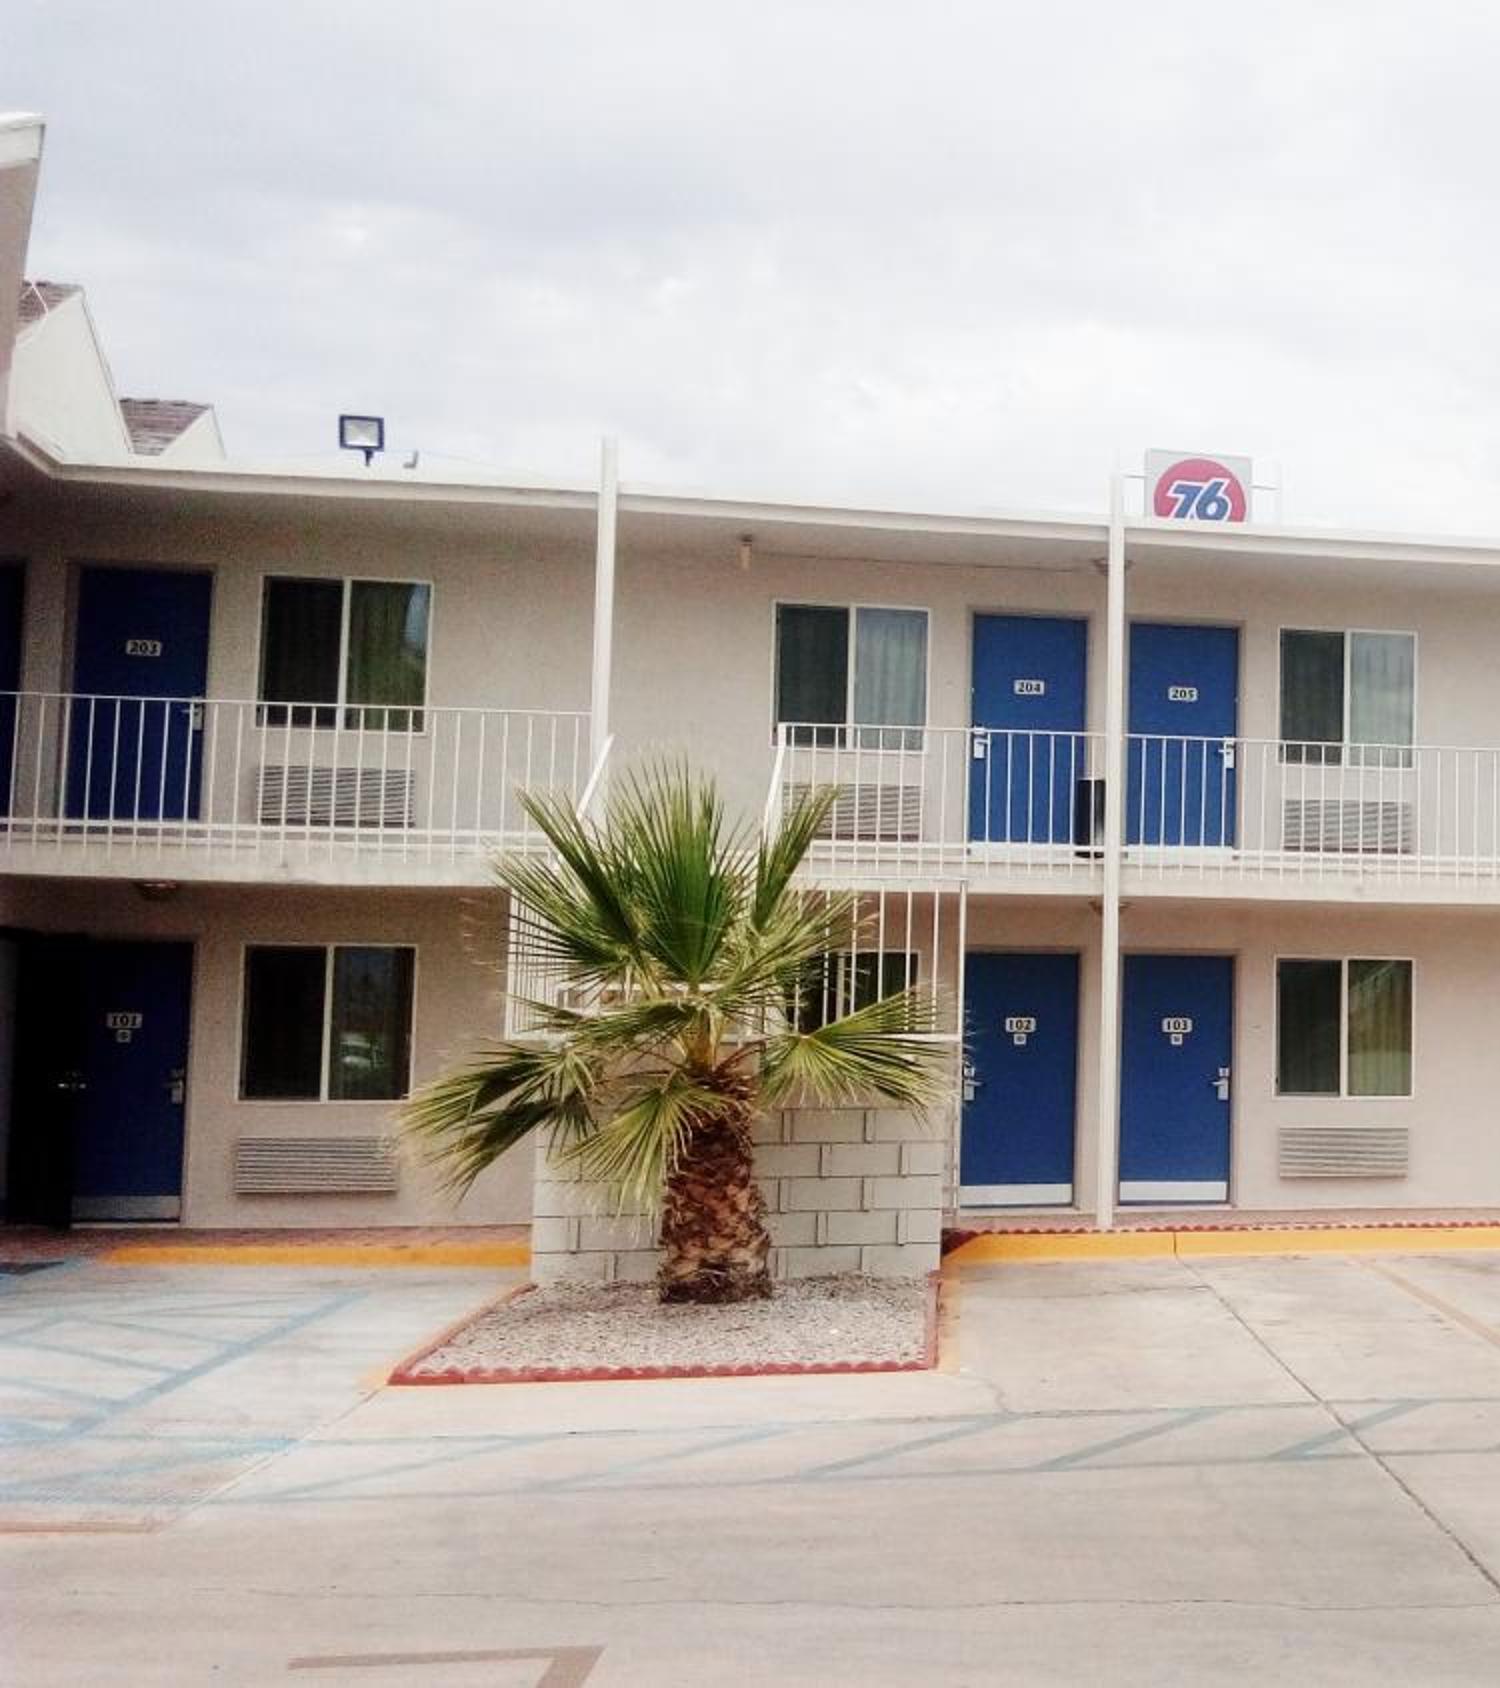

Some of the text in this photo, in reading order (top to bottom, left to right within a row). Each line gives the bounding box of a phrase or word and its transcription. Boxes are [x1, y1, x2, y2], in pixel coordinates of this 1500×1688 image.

[1166, 478, 1232, 520] 76
[131, 641, 158, 655] 203
[1017, 681, 1041, 693] 204
[1172, 687, 1195, 700] 205
[112, 1014, 138, 1027] 101
[1009, 1019, 1032, 1031] 102
[1166, 1019, 1189, 1031] 103
